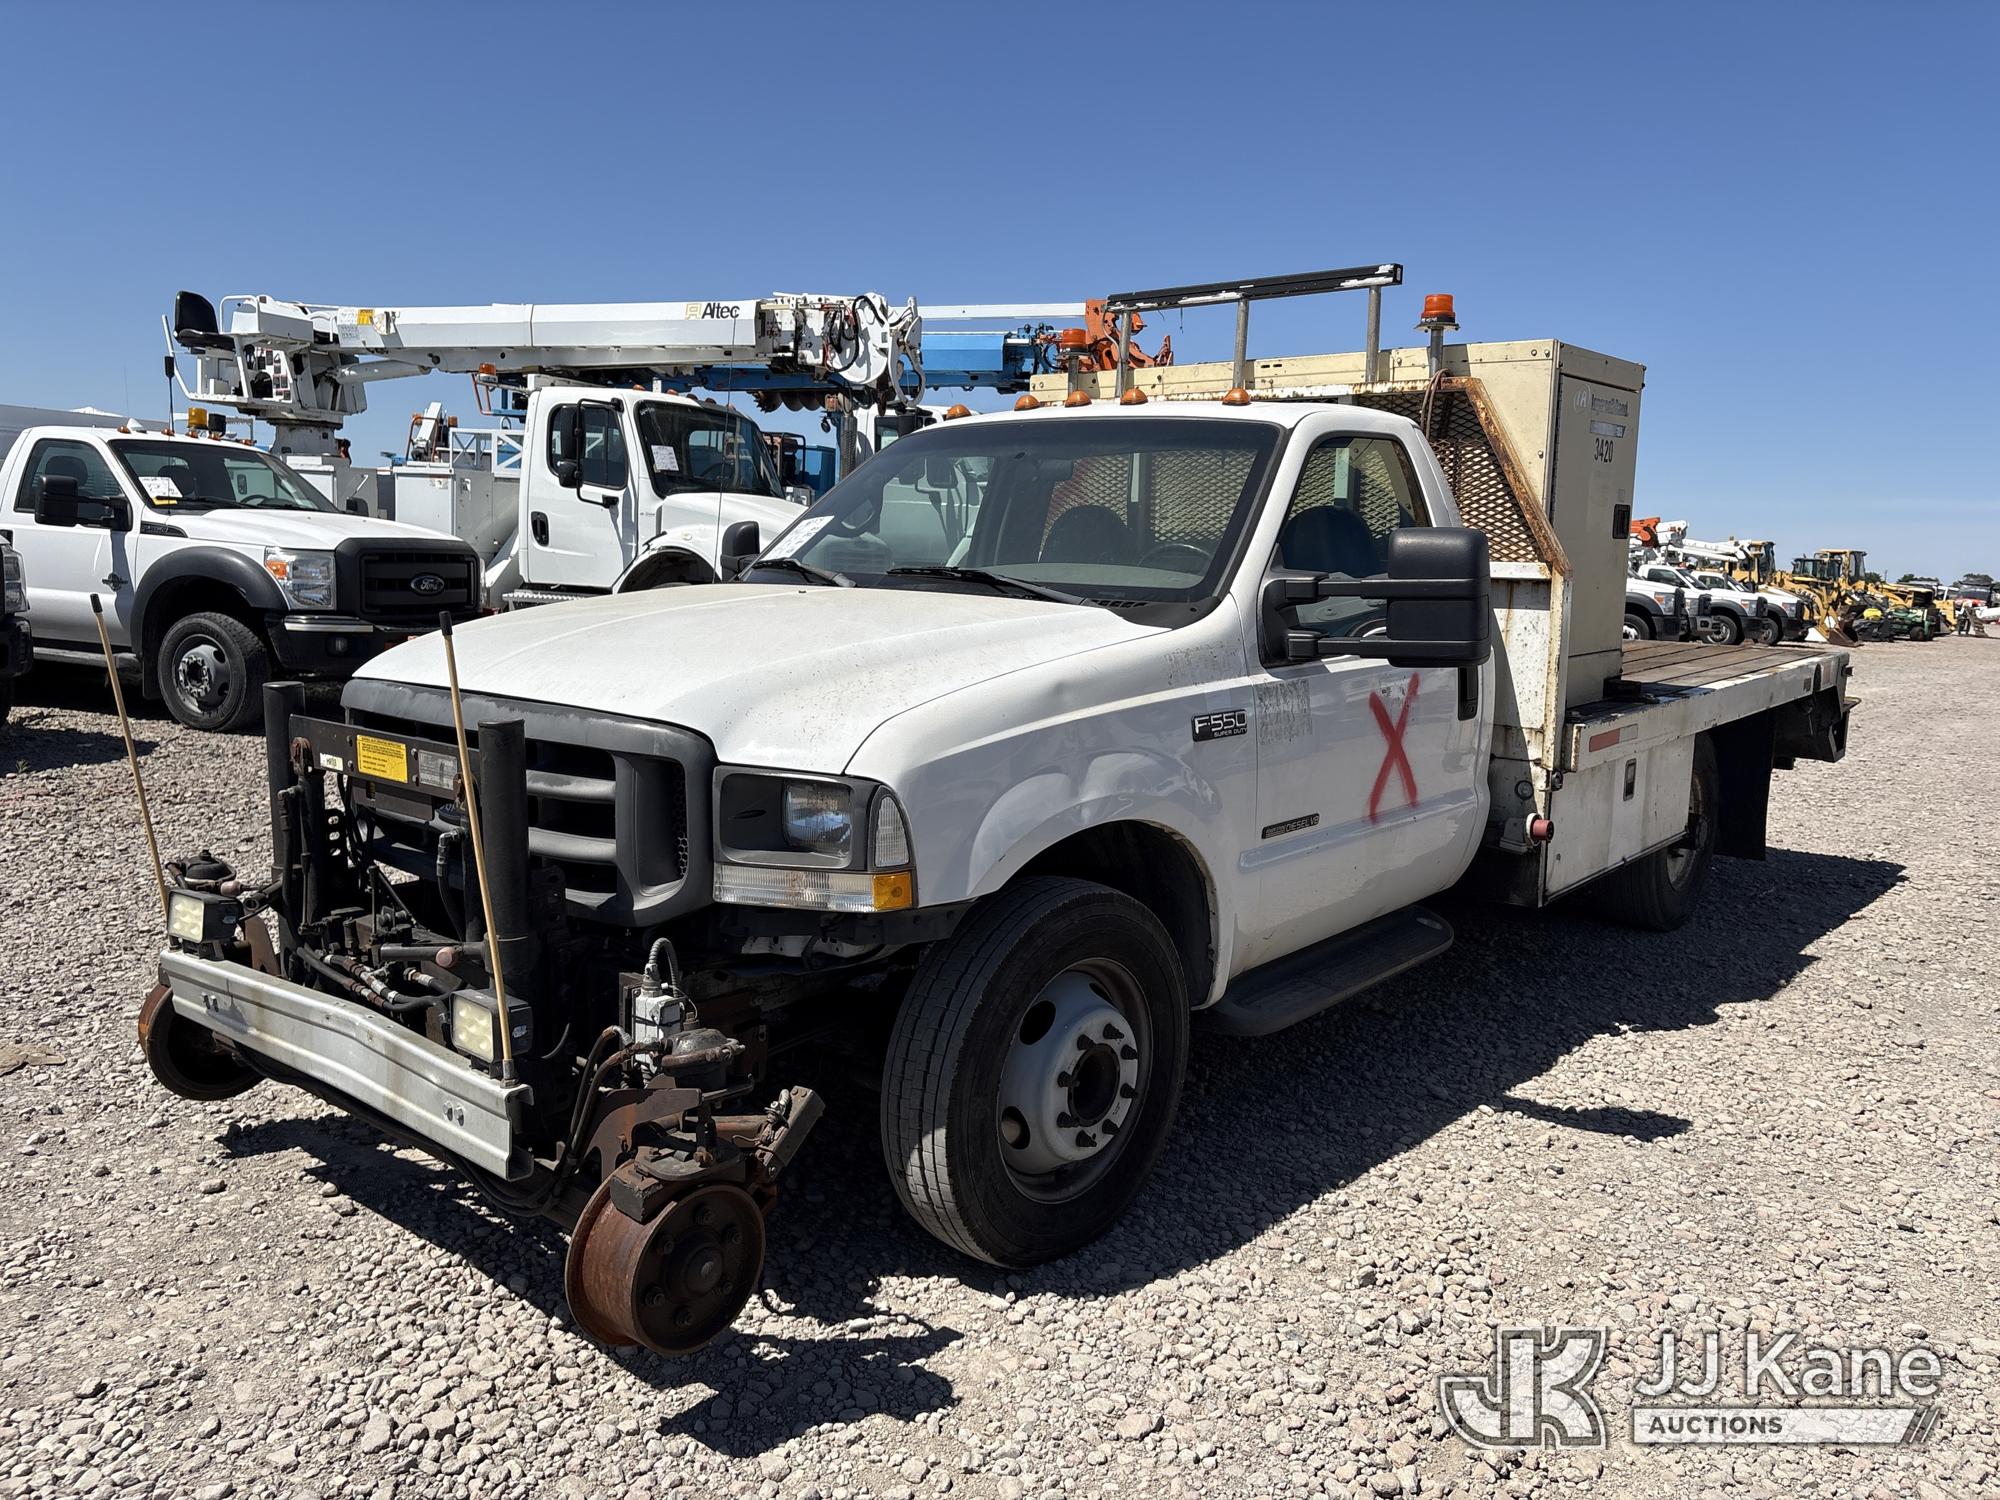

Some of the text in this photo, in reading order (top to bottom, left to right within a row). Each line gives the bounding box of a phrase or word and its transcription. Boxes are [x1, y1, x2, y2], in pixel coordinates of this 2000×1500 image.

[701, 302, 740, 320] Altec
[1594, 438, 1614, 463] 3420
[1213, 727, 1248, 738] SUPER DUTY
[1285, 818, 1310, 832] DIESEL
[1310, 815, 1320, 825] V8
